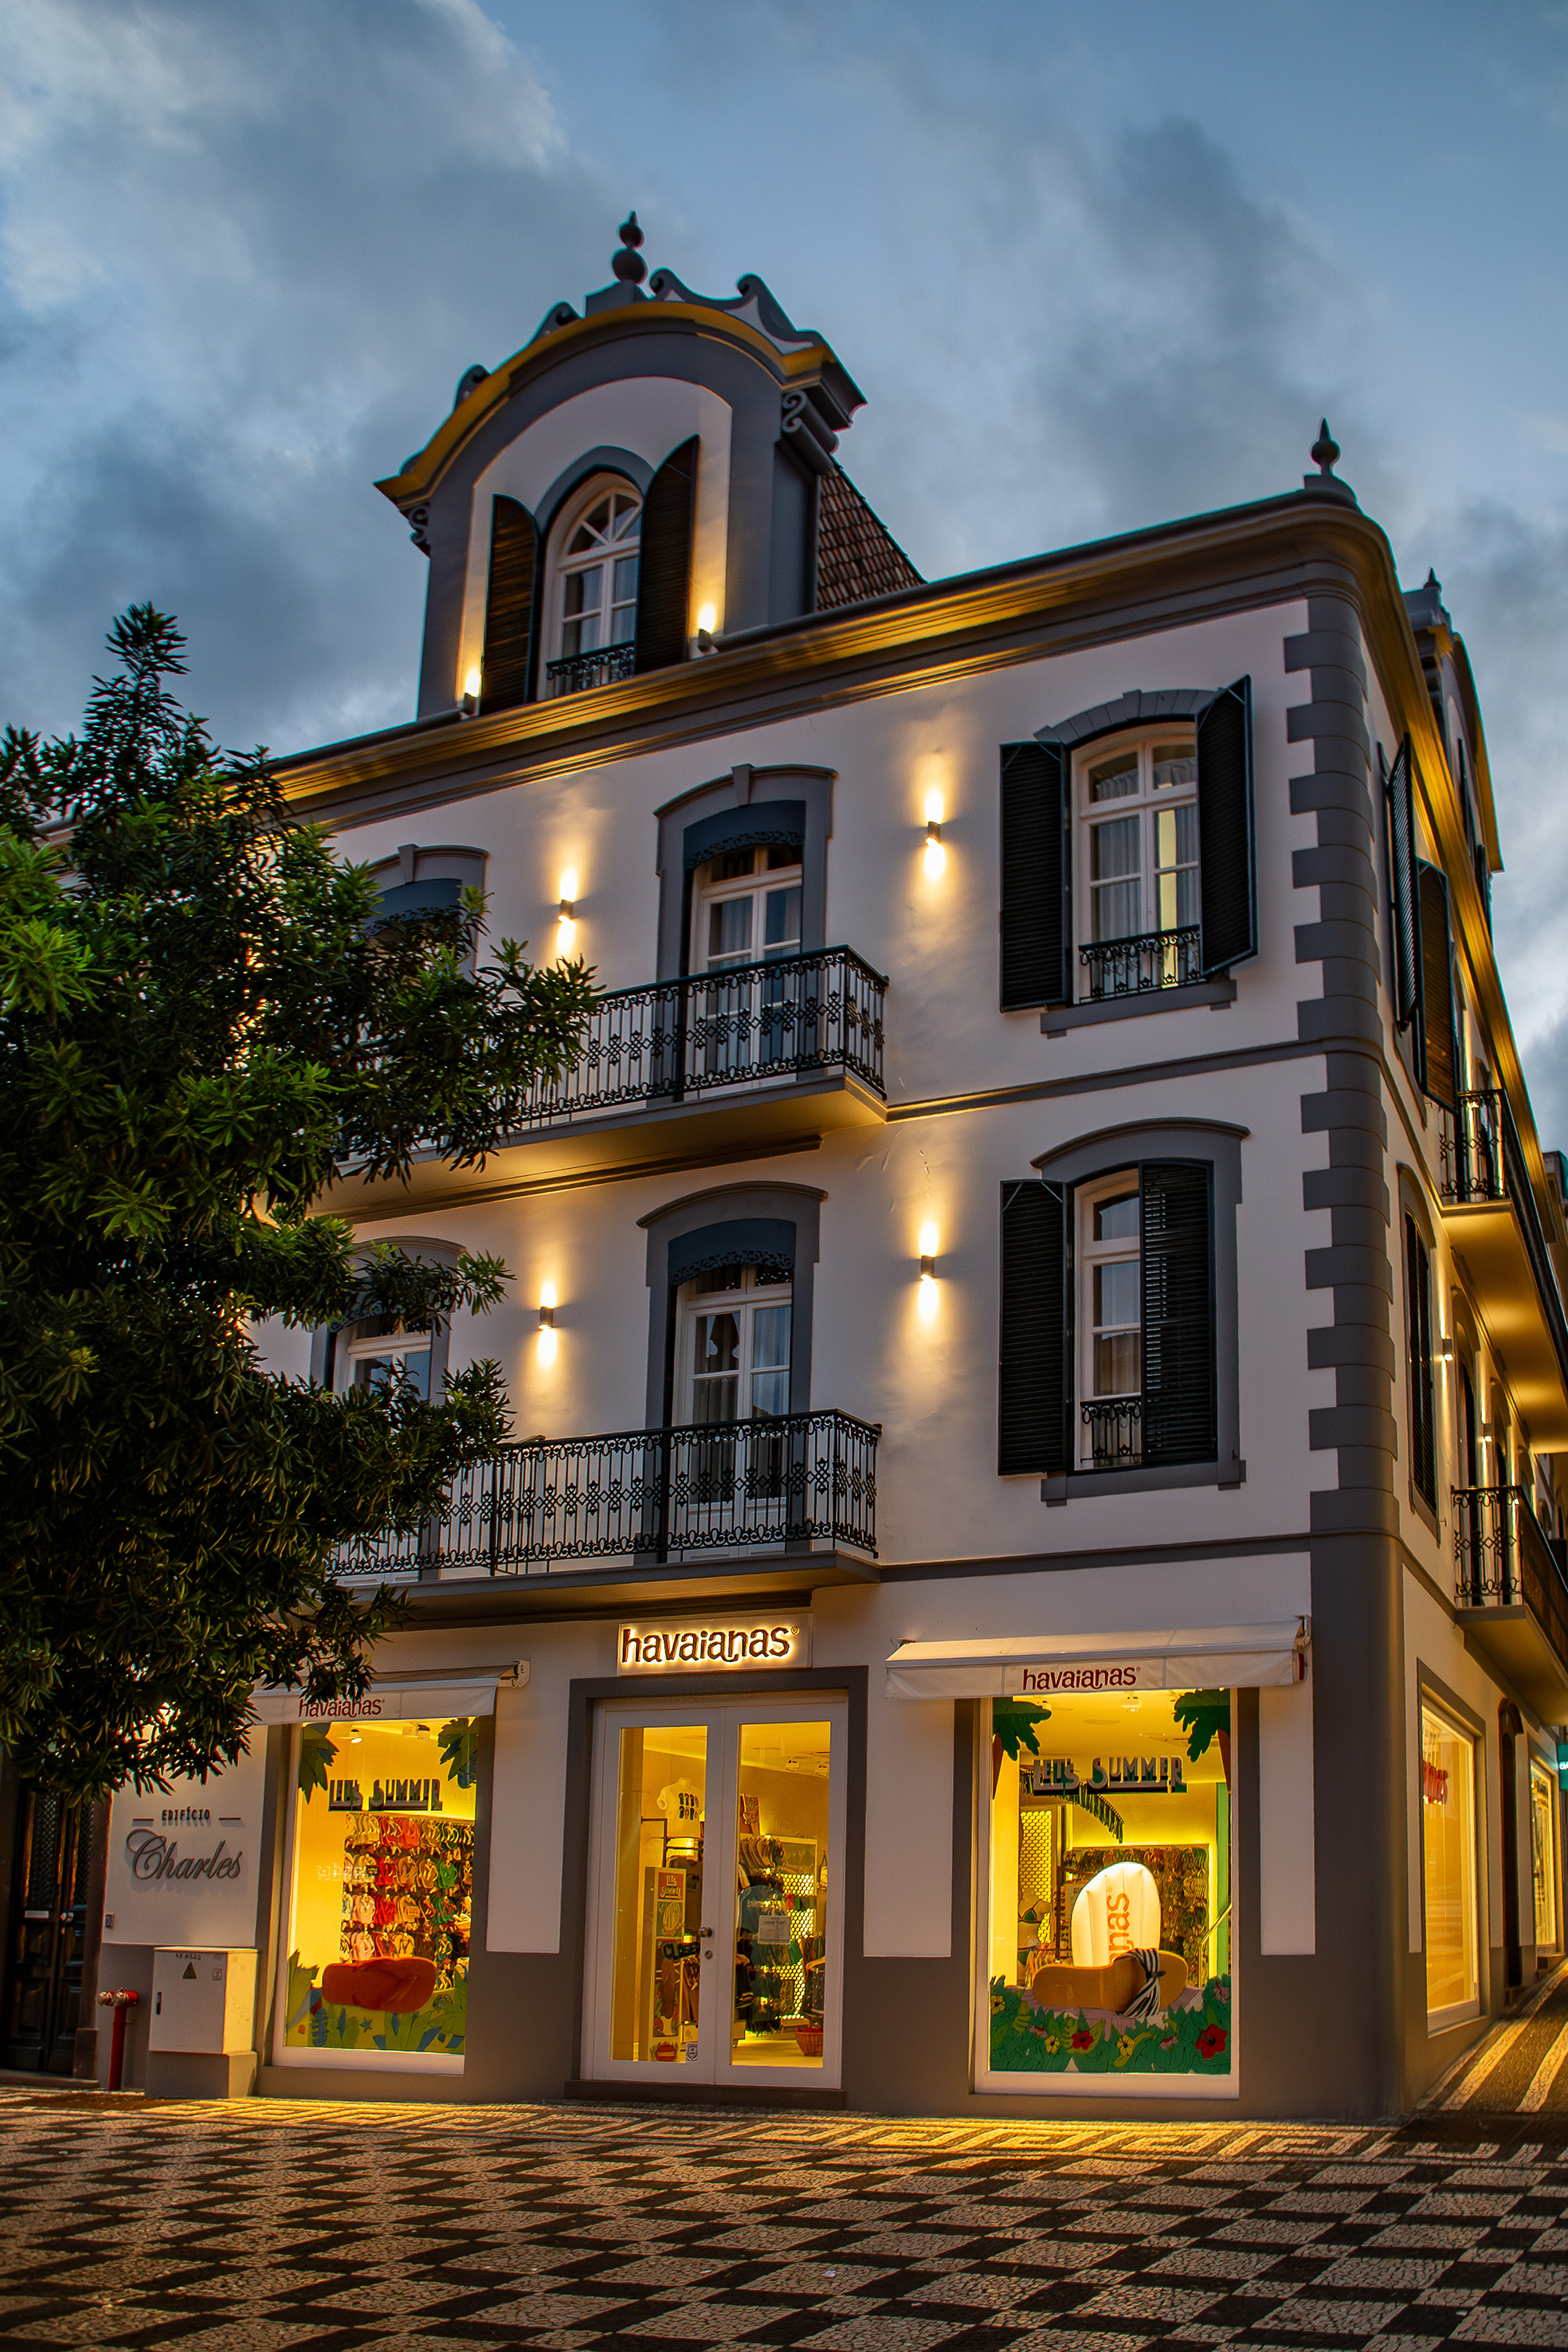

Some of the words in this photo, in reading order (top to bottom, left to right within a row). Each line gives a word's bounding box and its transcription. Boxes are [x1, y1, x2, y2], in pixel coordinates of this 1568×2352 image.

[622, 1627, 790, 1663] havaianas
[1022, 1667, 1137, 1690] havaianas
[299, 1698, 382, 1718] havaianas
[1087, 1755, 1187, 1793] SUMMER
[161, 1805, 210, 1821] EDIFÍCIO
[127, 1828, 243, 1880] Charles
